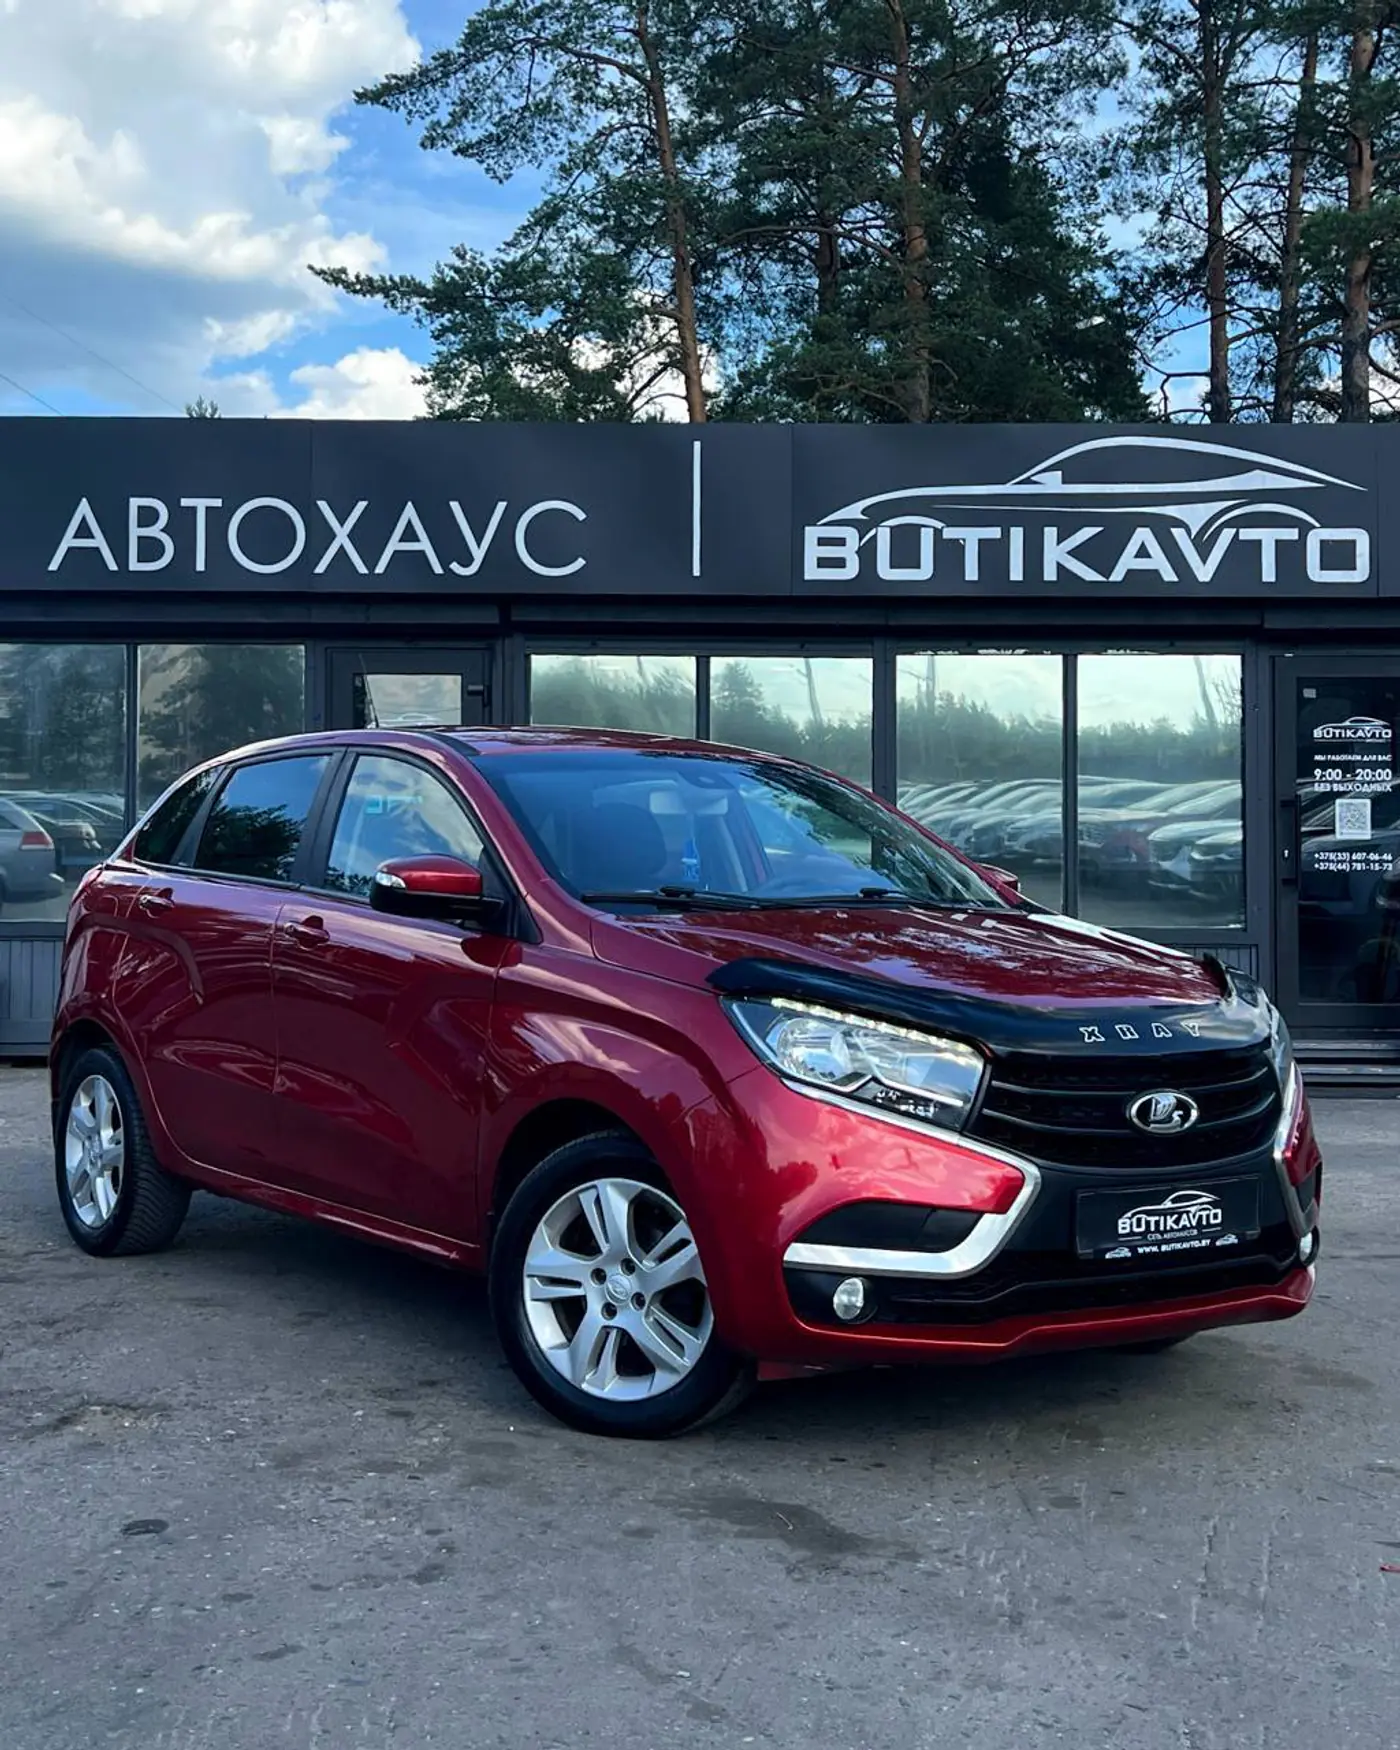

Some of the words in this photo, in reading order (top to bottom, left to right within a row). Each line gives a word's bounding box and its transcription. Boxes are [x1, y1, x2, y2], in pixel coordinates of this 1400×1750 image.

[47, 497, 588, 577] АВТОХАУС
[804, 525, 1371, 583] BUTIKAVTO
[1313, 728, 1392, 738] BUTIKAVTO
[1314, 768, 1342, 780] 9:00
[1356, 768, 1392, 780] 20:00
[1314, 783, 1330, 792] БЕЗ
[1333, 783, 1392, 792] ВЫХОДНЫХ
[1118, 1209, 1222, 1234] BUTIKAVTO
